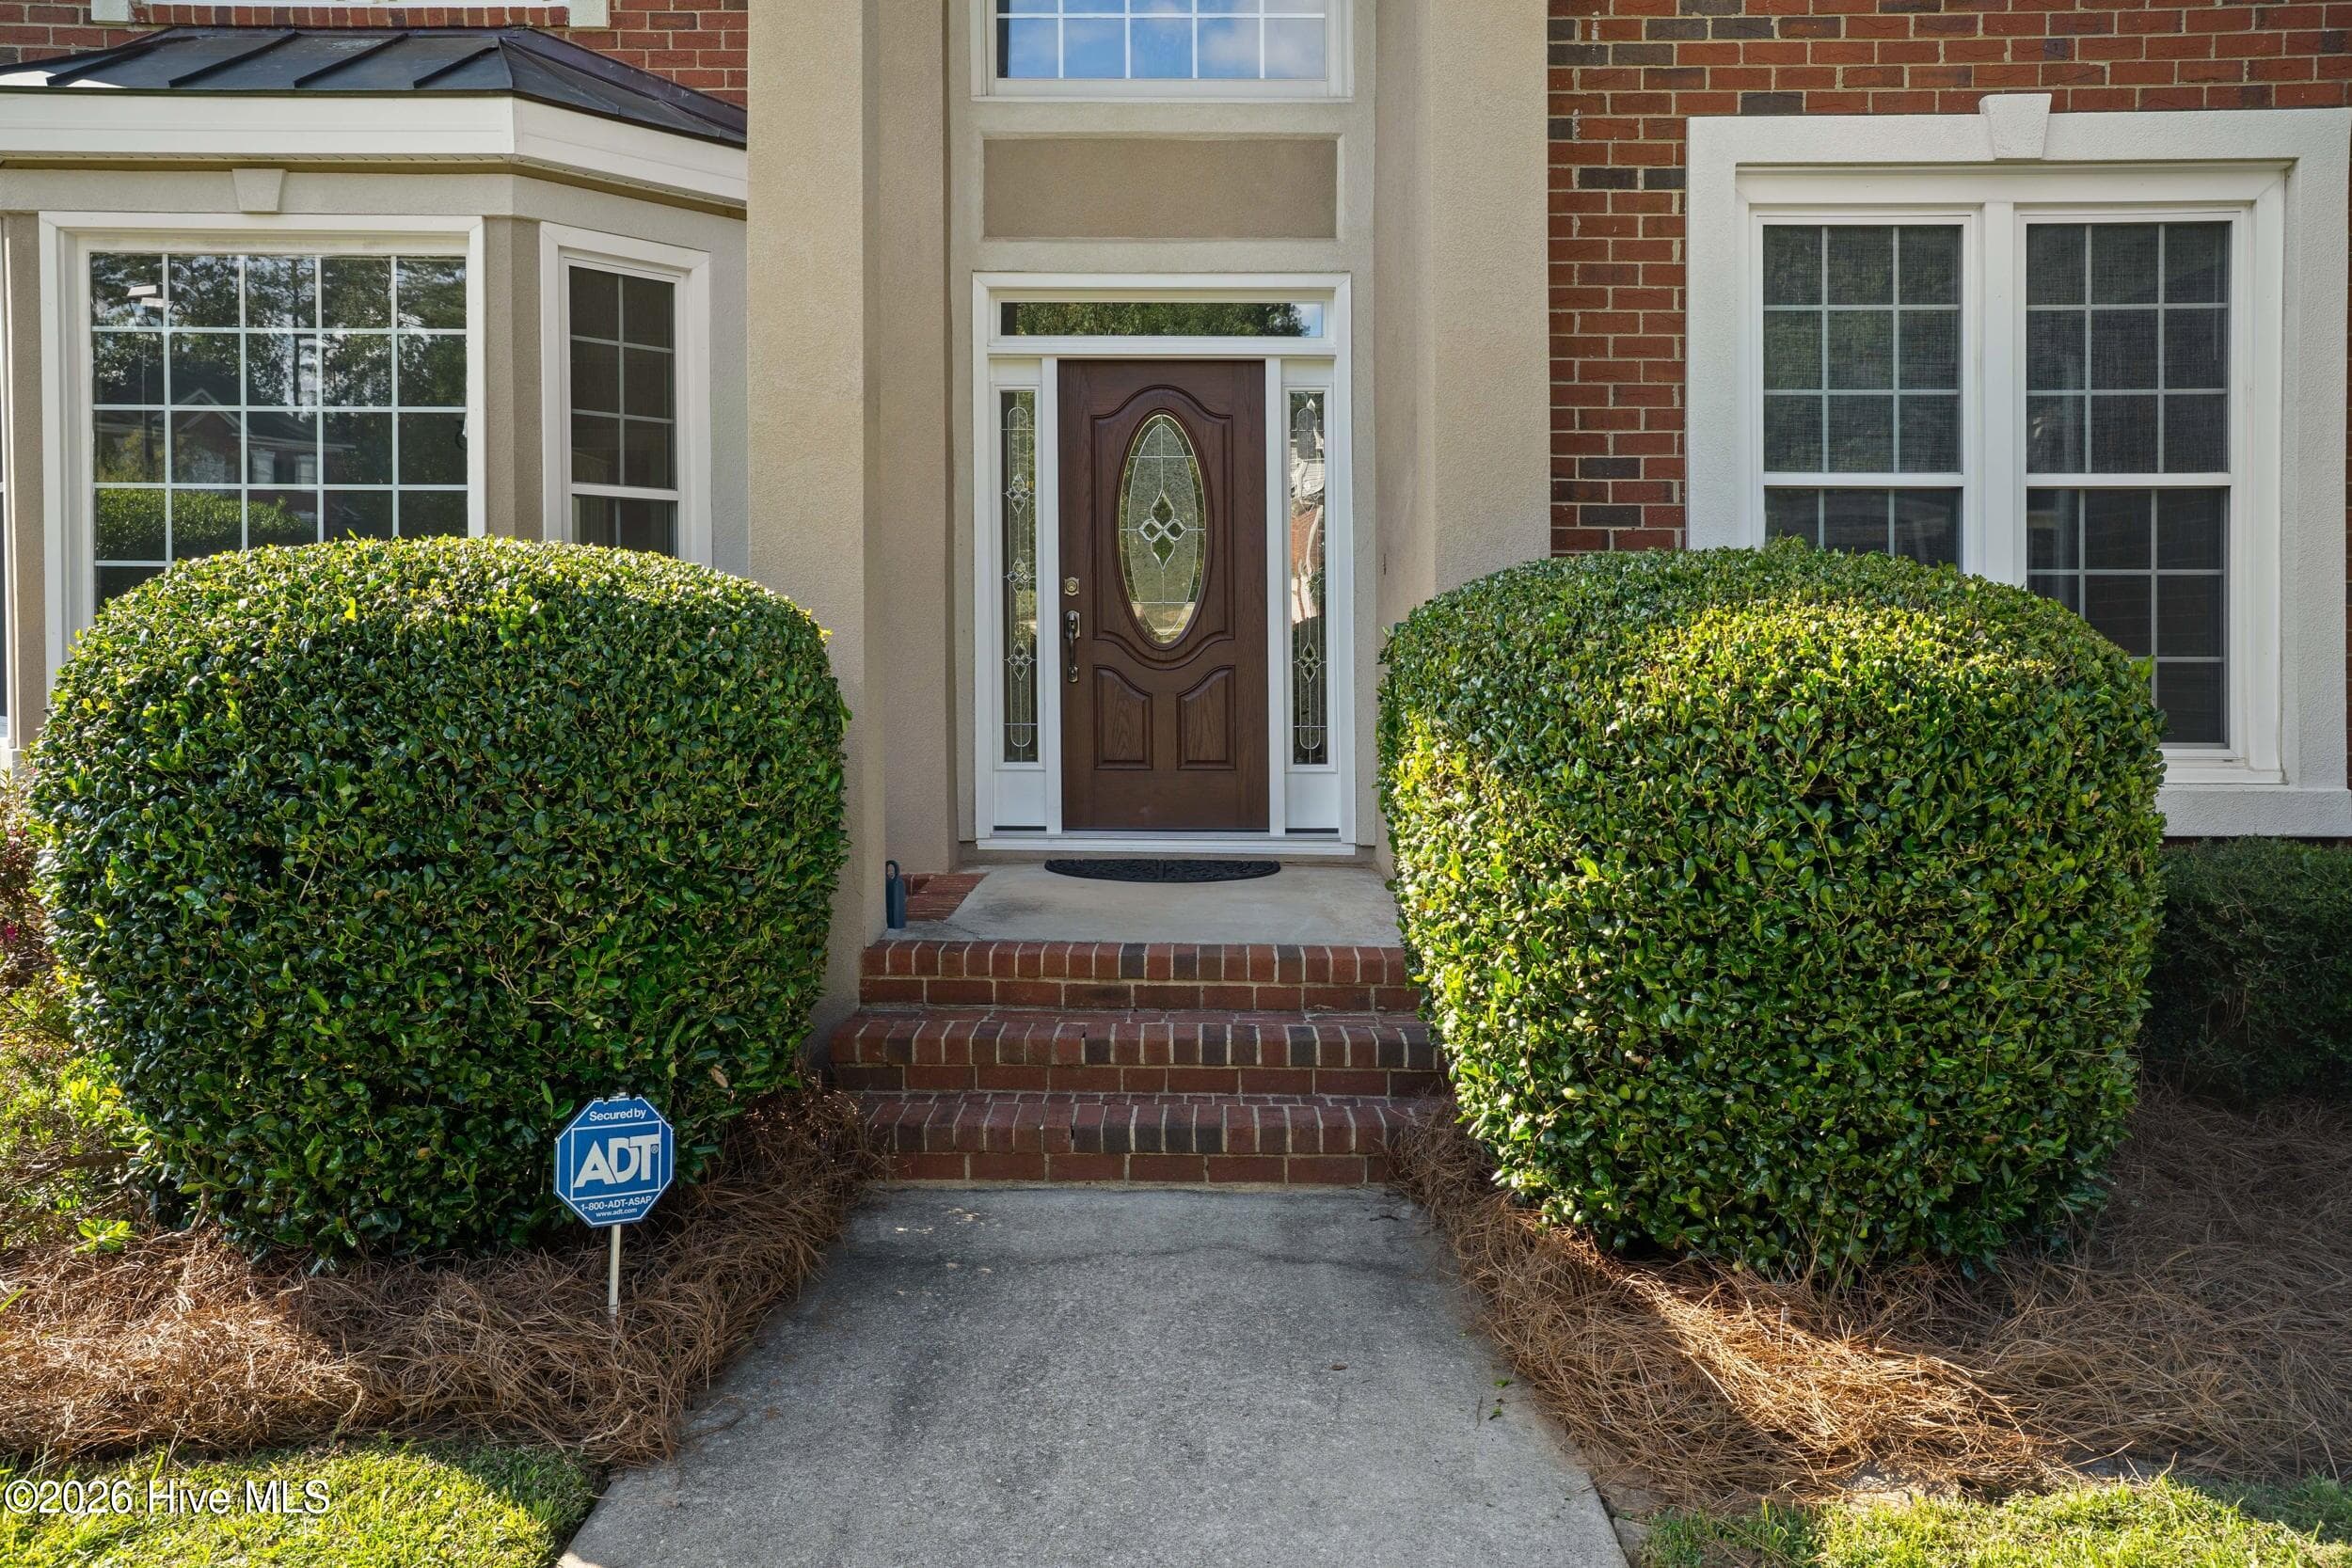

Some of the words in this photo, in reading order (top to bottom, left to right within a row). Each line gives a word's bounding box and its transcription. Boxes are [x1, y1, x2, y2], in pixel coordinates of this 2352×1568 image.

[589, 1108, 633, 1121] Secured
[633, 1107, 647, 1119] by
[580, 1196, 652, 1212] 1-800-ADT-ASAP
[596, 1208, 638, 1217] www.adt.com
